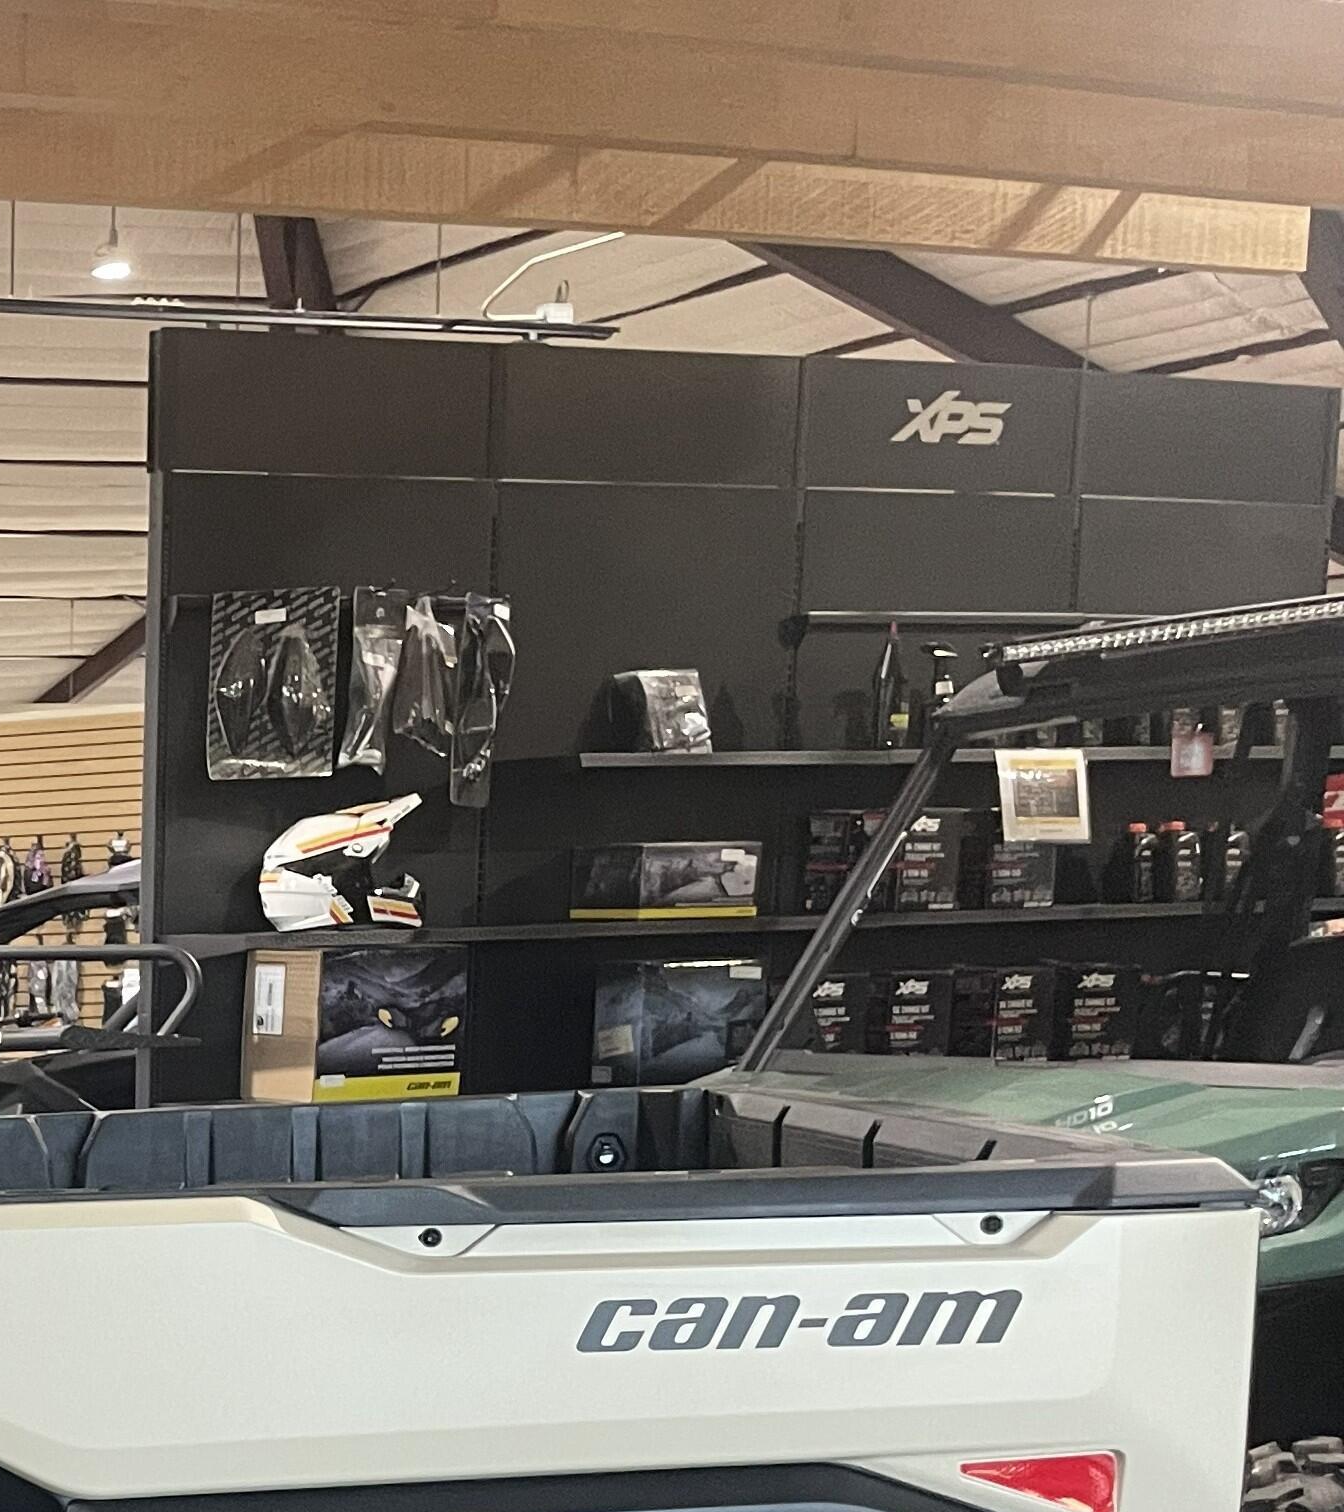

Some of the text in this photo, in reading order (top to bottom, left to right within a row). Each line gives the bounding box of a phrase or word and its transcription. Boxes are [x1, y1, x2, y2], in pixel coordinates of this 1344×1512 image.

[890, 390, 1013, 446] XPS
[895, 978, 930, 996] XPS
[1001, 972, 1034, 990] XPS
[1076, 972, 1117, 989] XPS
[576, 1288, 1023, 1353] can-am
